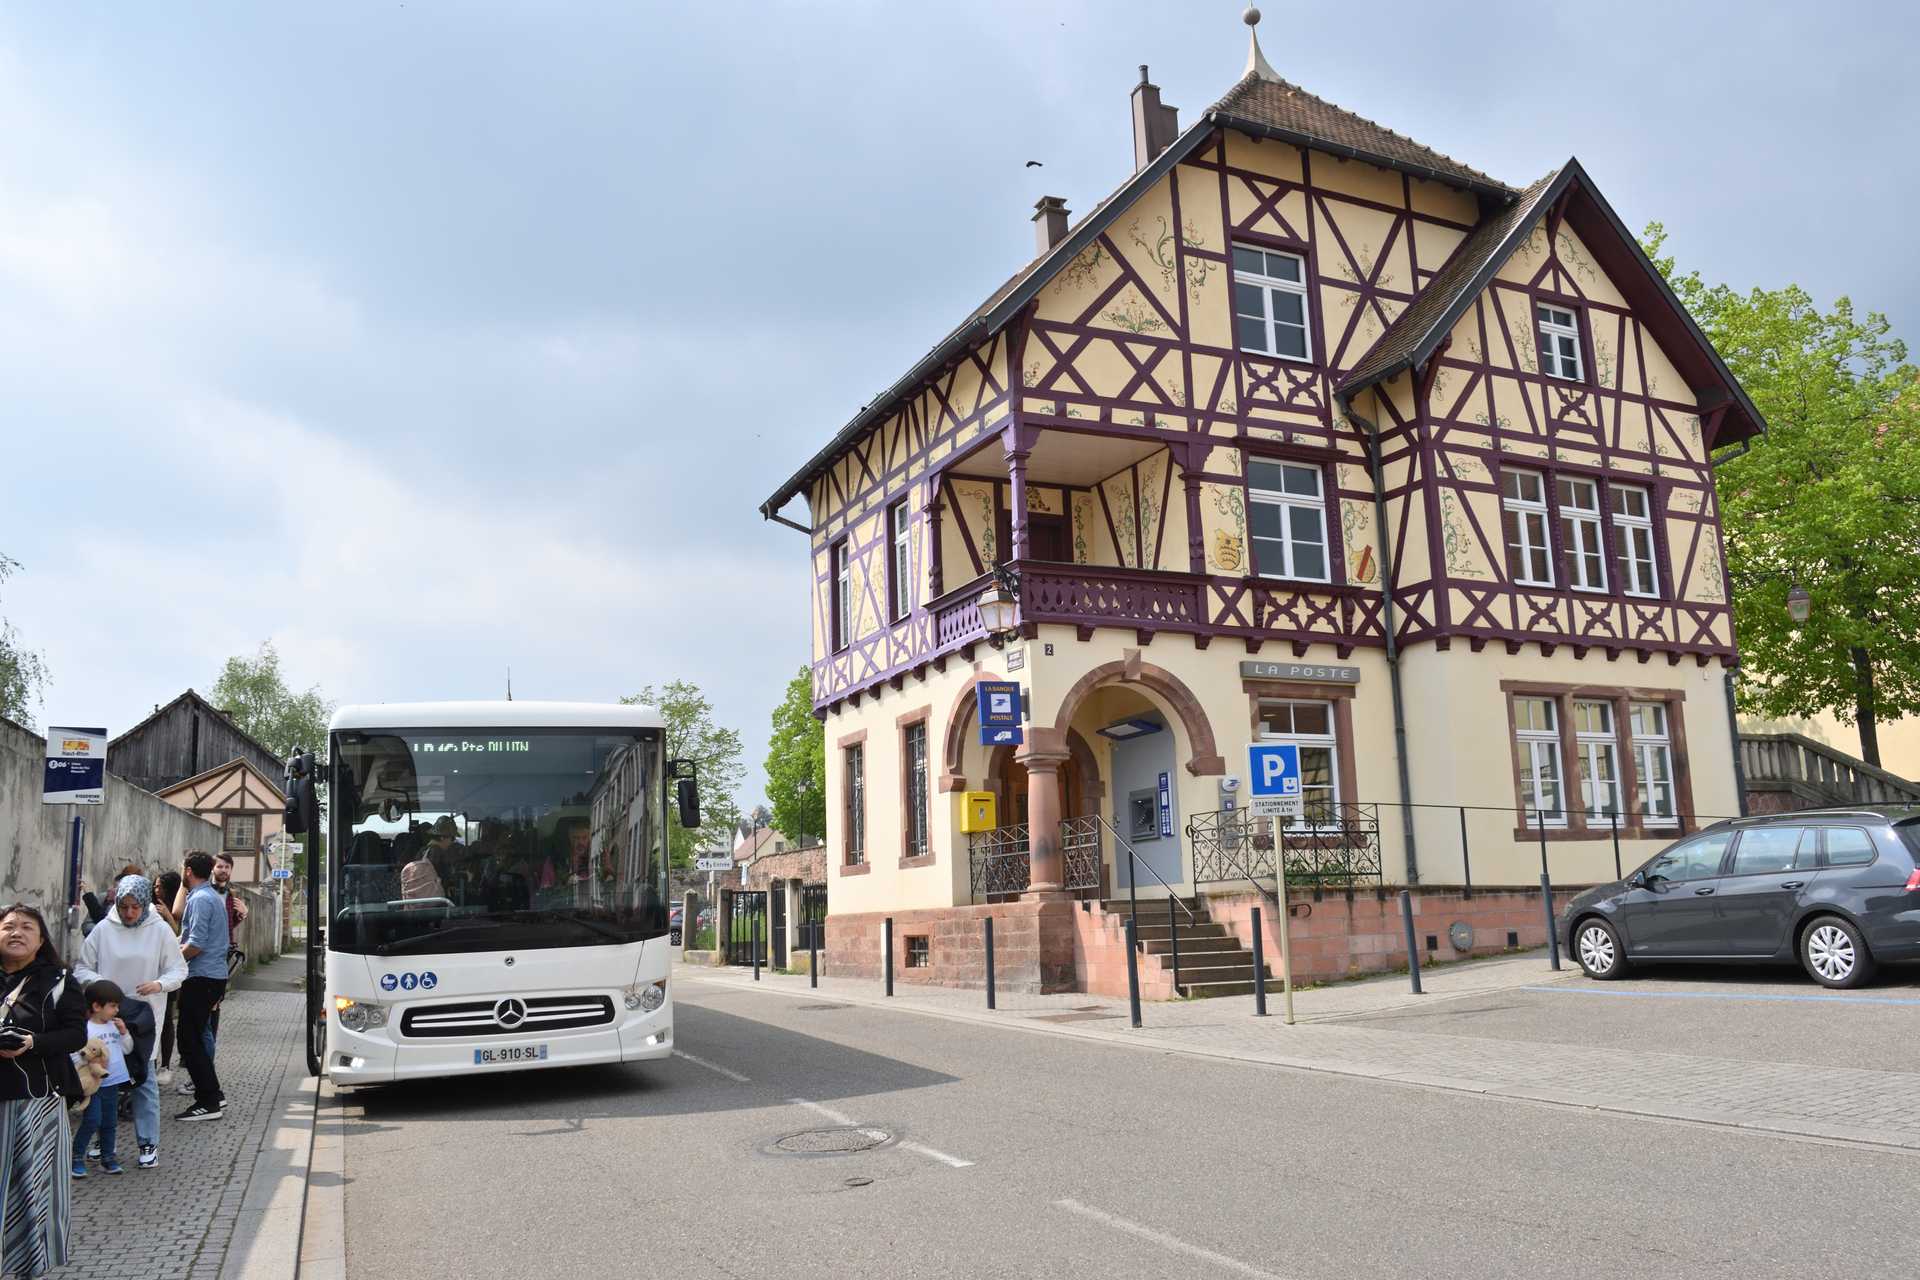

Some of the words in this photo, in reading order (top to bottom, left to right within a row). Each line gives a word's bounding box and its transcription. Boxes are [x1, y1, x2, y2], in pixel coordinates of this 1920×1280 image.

[1255, 664, 1278, 675] LA
[1290, 666, 1352, 679] POSTE
[1262, 754, 1286, 787] P
[1254, 800, 1299, 808] STATIONNEMENT
[482, 1047, 539, 1061] GL-910-SL
